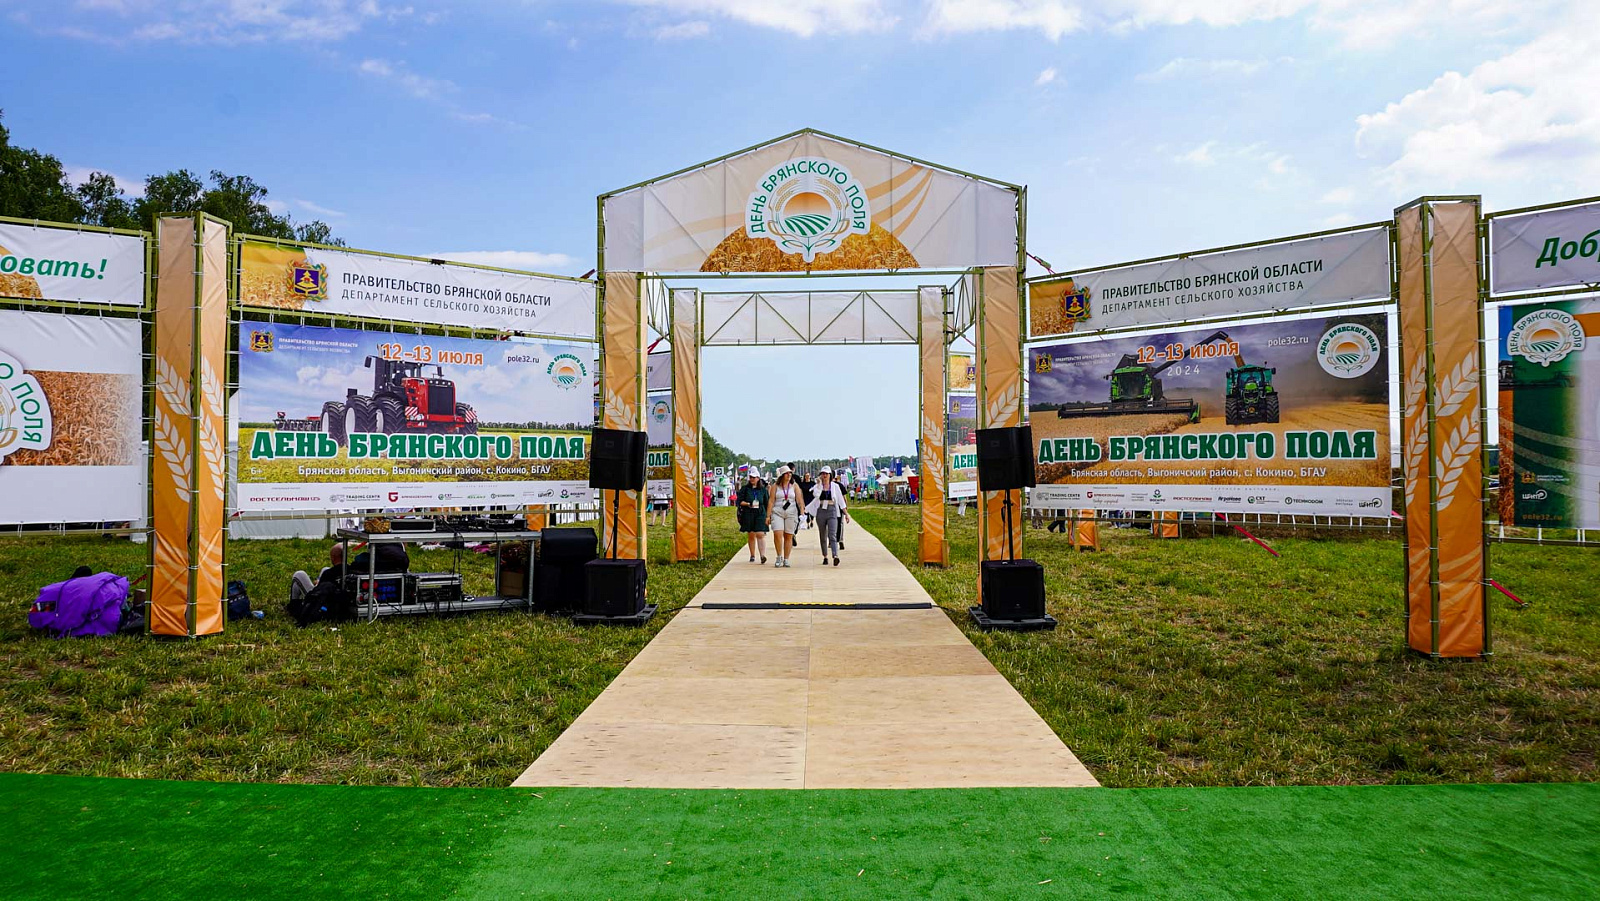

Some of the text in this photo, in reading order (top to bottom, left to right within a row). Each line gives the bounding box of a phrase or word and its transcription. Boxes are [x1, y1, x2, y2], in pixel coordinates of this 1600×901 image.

[750, 160, 866, 233] ДЕНЬ БРЯНСКОГО ПОЛЯ
[1535, 229, 1600, 268] Доб
[342, 272, 551, 306] ПРАВИТЕЛЬСТВО БРЯНСКОЙ ОБЛАСТИ
[1102, 259, 1323, 300] ПРАВИТЕЛЬСТВО БРЯНСКОЙ ОБЛАСТИ
[342, 288, 536, 318] ДЕПАРТАМЕНТ СЕЛЬСКОГО ХОЗЯЙСТВА
[1102, 280, 1304, 315] ДЕПАРТАМЕНТ СЕЛЬСКОГО ХОЗЯЙСТВА
[1268, 336, 1309, 347] pole32.ru
[1319, 338, 1330, 355] ДЕНЬ
[1328, 325, 1367, 339] БРЯНСКОГО
[1510, 312, 1582, 353] ДЕНЬ БРЯНСКОГО ПОЛЯ
[438, 351, 483, 365] июля
[507, 354, 540, 364] pole32.ru
[1190, 341, 1240, 359] июля
[1167, 364, 1200, 377] 2024
[11, 381, 43, 443] ПОЛЯ
[251, 431, 585, 459] ДЕНЬ БРЯНСКОГО ПОЛЯ
[648, 452, 670, 466] ОЛЯ
[1038, 430, 1377, 464] ДЕНЬ БРЯНСКОГО ПОЛЯ
[298, 465, 346, 476] Брянская
[348, 465, 389, 476] область,
[392, 466, 452, 476] Выгоничский
[455, 467, 483, 476] район,
[496, 466, 528, 476] Кокино,
[531, 466, 551, 475] БГАУ
[1071, 467, 1327, 478] Брянская область, Выгоничский район, с. Кокино, БГАУ
